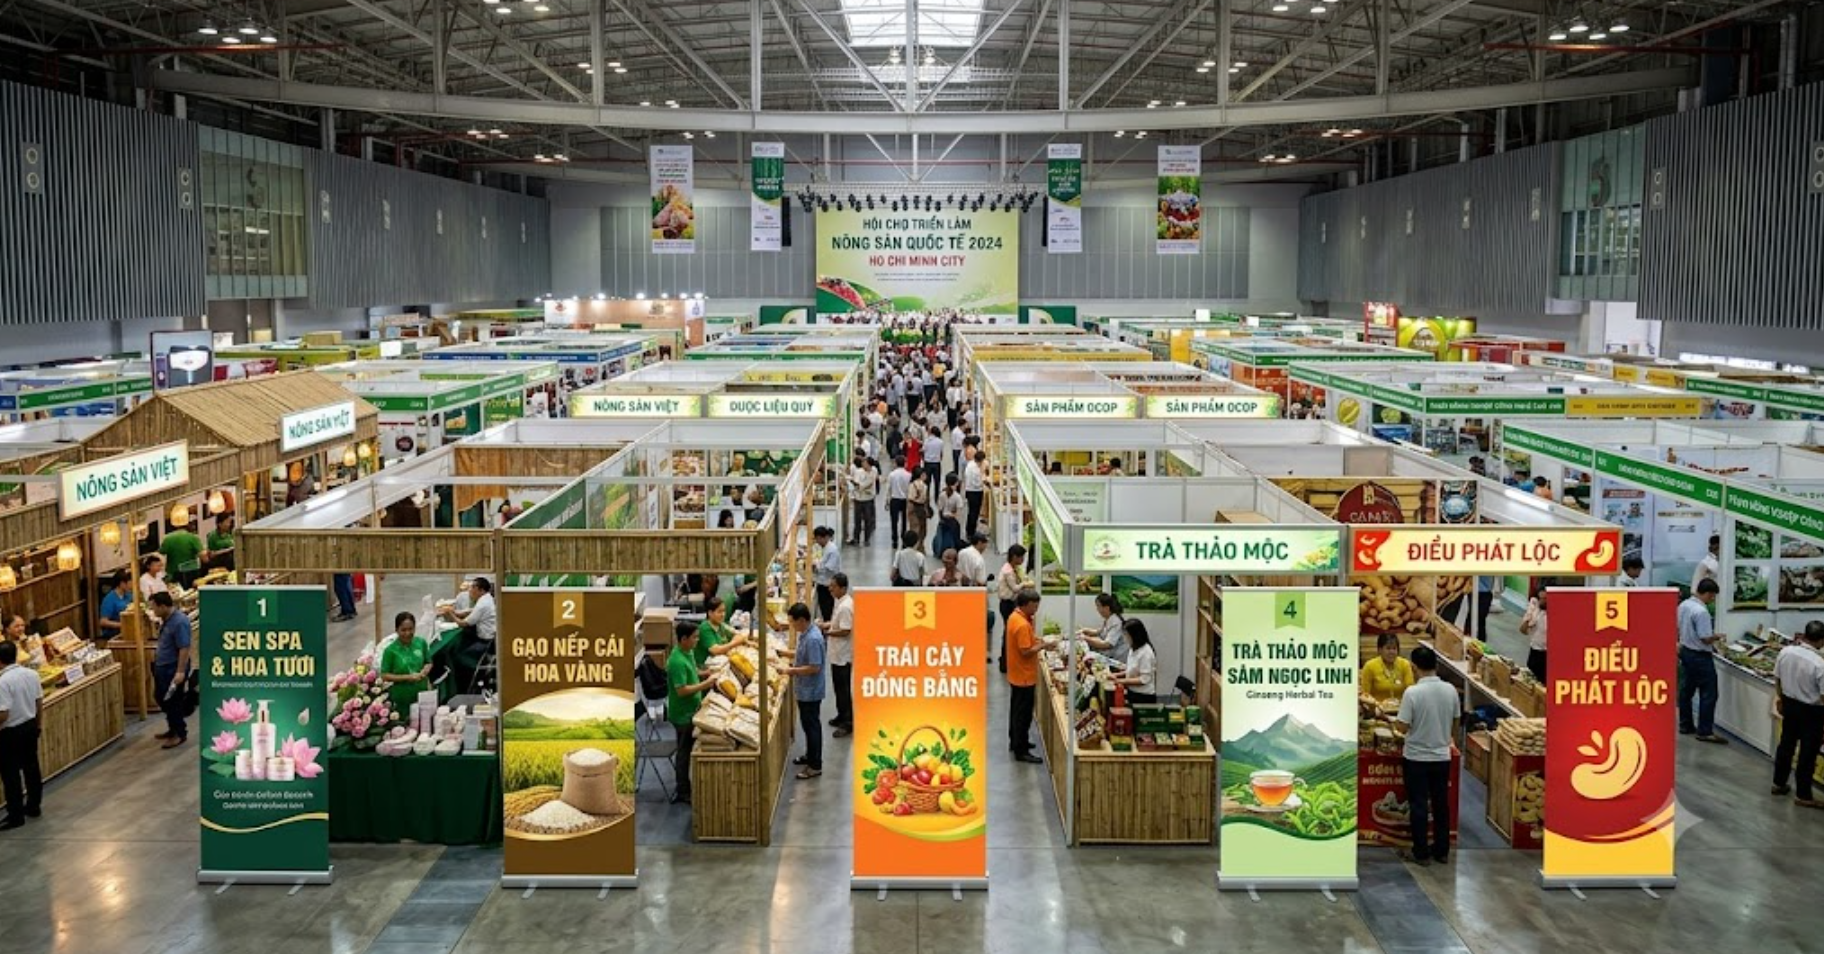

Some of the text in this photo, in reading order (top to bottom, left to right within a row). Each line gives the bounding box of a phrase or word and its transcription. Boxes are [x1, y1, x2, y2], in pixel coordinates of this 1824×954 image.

[832, 233, 871, 250] NÔNG
[968, 237, 1003, 250] 2024
[887, 255, 906, 267] CHI
[909, 255, 937, 267] MINH
[940, 255, 966, 267] CITY
[654, 399, 679, 414] VIỆT
[1087, 402, 1118, 413] OCOP
[1227, 402, 1258, 413] OCOP
[76, 456, 178, 501] NÔNG SẢN VIỆT
[1182, 535, 1238, 560] THẢO
[1243, 538, 1289, 564] MỘC
[1462, 538, 1515, 562] PHÁT
[1521, 539, 1560, 566] LỘC
[257, 597, 267, 617] 1
[562, 600, 576, 619] 2
[913, 600, 927, 619] 3
[1283, 600, 1297, 619] 4
[1605, 601, 1618, 619] 5
[222, 631, 303, 650] SEN SPA
[511, 631, 625, 660] GẠO NẾP CÁI
[1267, 637, 1307, 660] THẢO
[1312, 640, 1348, 663] MỘC
[875, 642, 964, 666] TRÁI CÂY
[211, 656, 225, 677] &
[231, 656, 268, 676] HOA
[524, 663, 560, 683] HOA
[1269, 667, 1312, 688] NGỌC
[1316, 667, 1352, 685] LINH
[1246, 690, 1334, 701] Ginseng Herbal Tea
[1555, 674, 1668, 710] PHÁT LỘC
